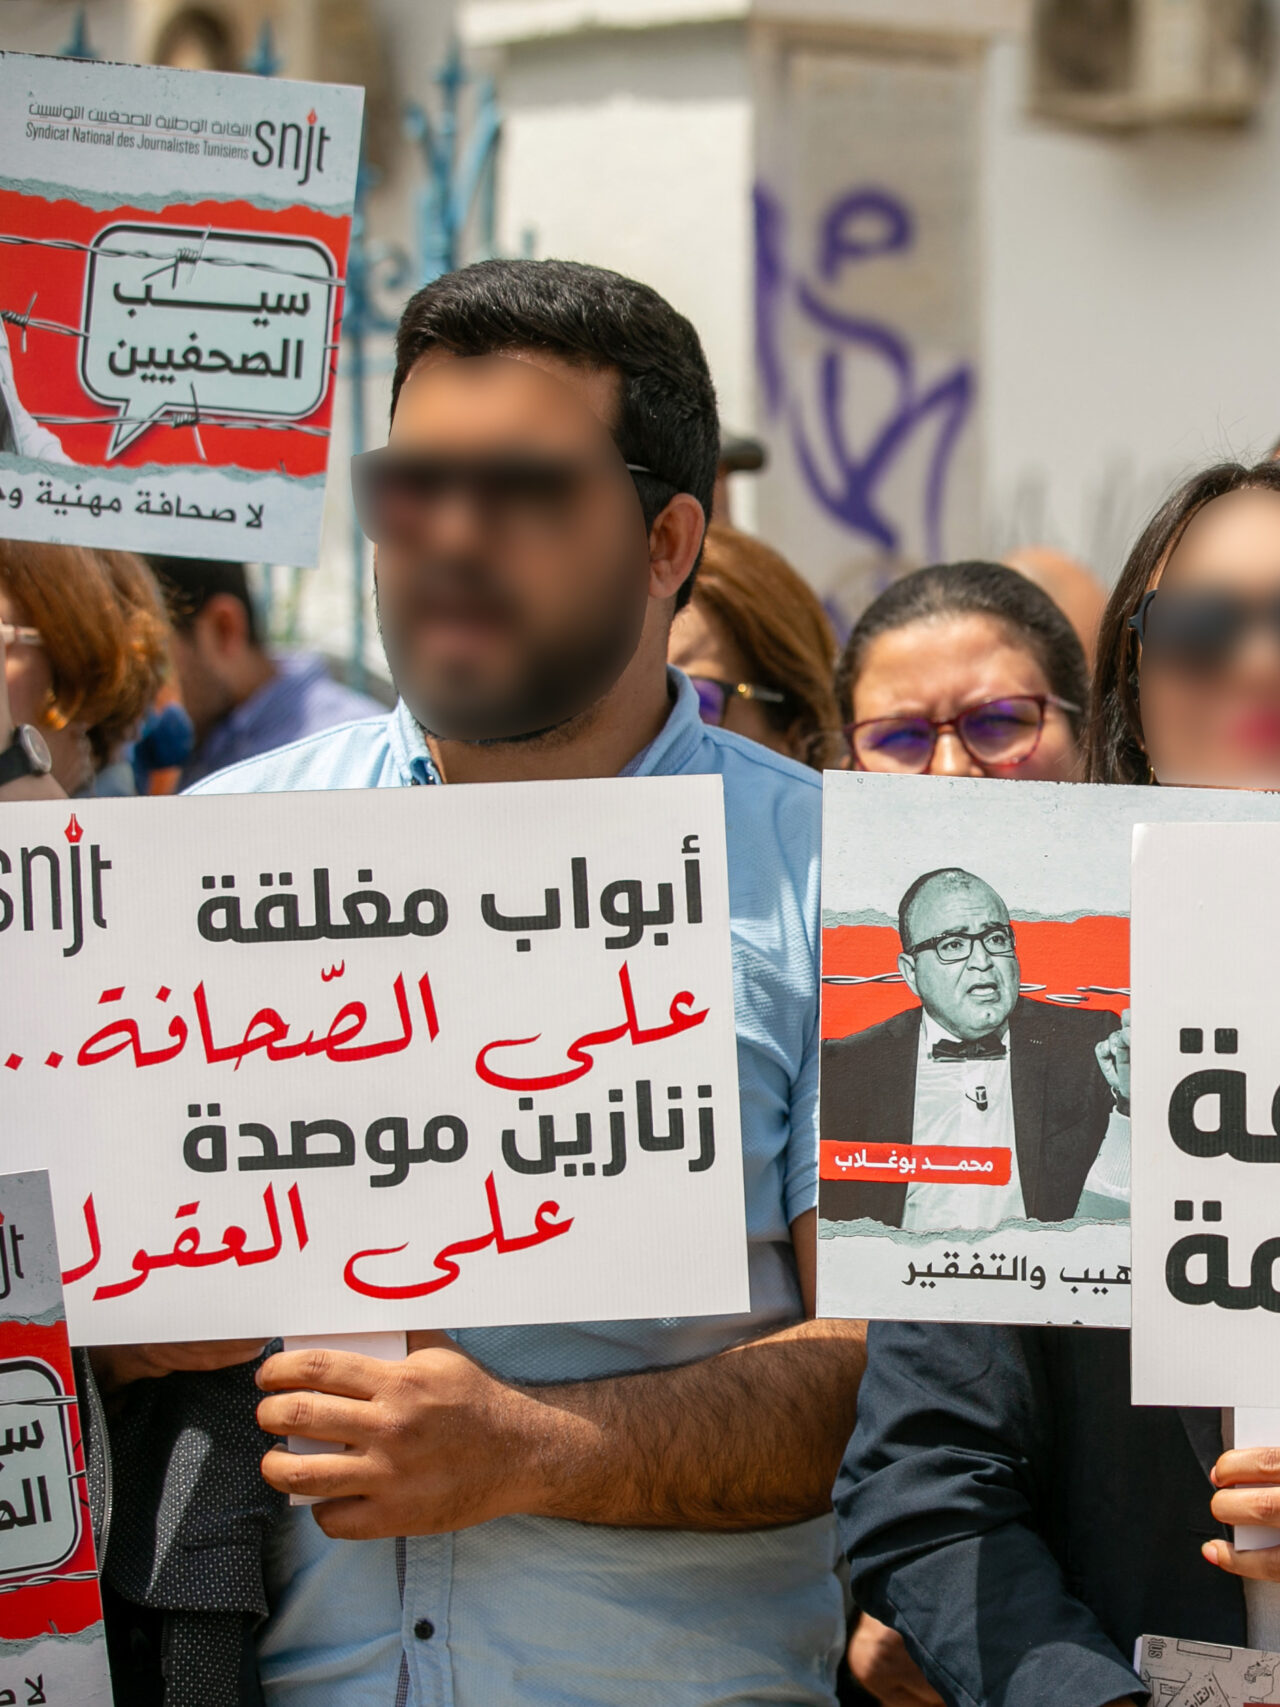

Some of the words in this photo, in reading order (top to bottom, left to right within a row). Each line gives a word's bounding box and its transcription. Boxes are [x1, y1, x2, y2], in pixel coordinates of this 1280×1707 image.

[25, 122, 69, 141] Syndicat
[72, 127, 115, 146] National
[116, 133, 135, 150] des
[136, 134, 200, 156] Journalistes
[203, 141, 250, 160] Tunisiens
[155, 114, 208, 135] الوطنية
[253, 107, 330, 187] snjt
[108, 331, 304, 384] الصحفيين
[36, 480, 122, 517] مهنية
[135, 490, 236, 523] صحافة
[245, 504, 264, 528] لا
[197, 868, 449, 943] مغلقة
[481, 835, 703, 952] أبواب
[476, 960, 711, 1091] على
[183, 1103, 468, 1188] موصدة
[501, 1080, 716, 1177] زنازين
[834, 1149, 917, 1174] بوغلاب
[922, 1156, 994, 1173] محمد
[61, 1181, 309, 1301] العقول
[344, 1170, 575, 1300] على
[902, 1251, 1046, 1290] والتفقير
